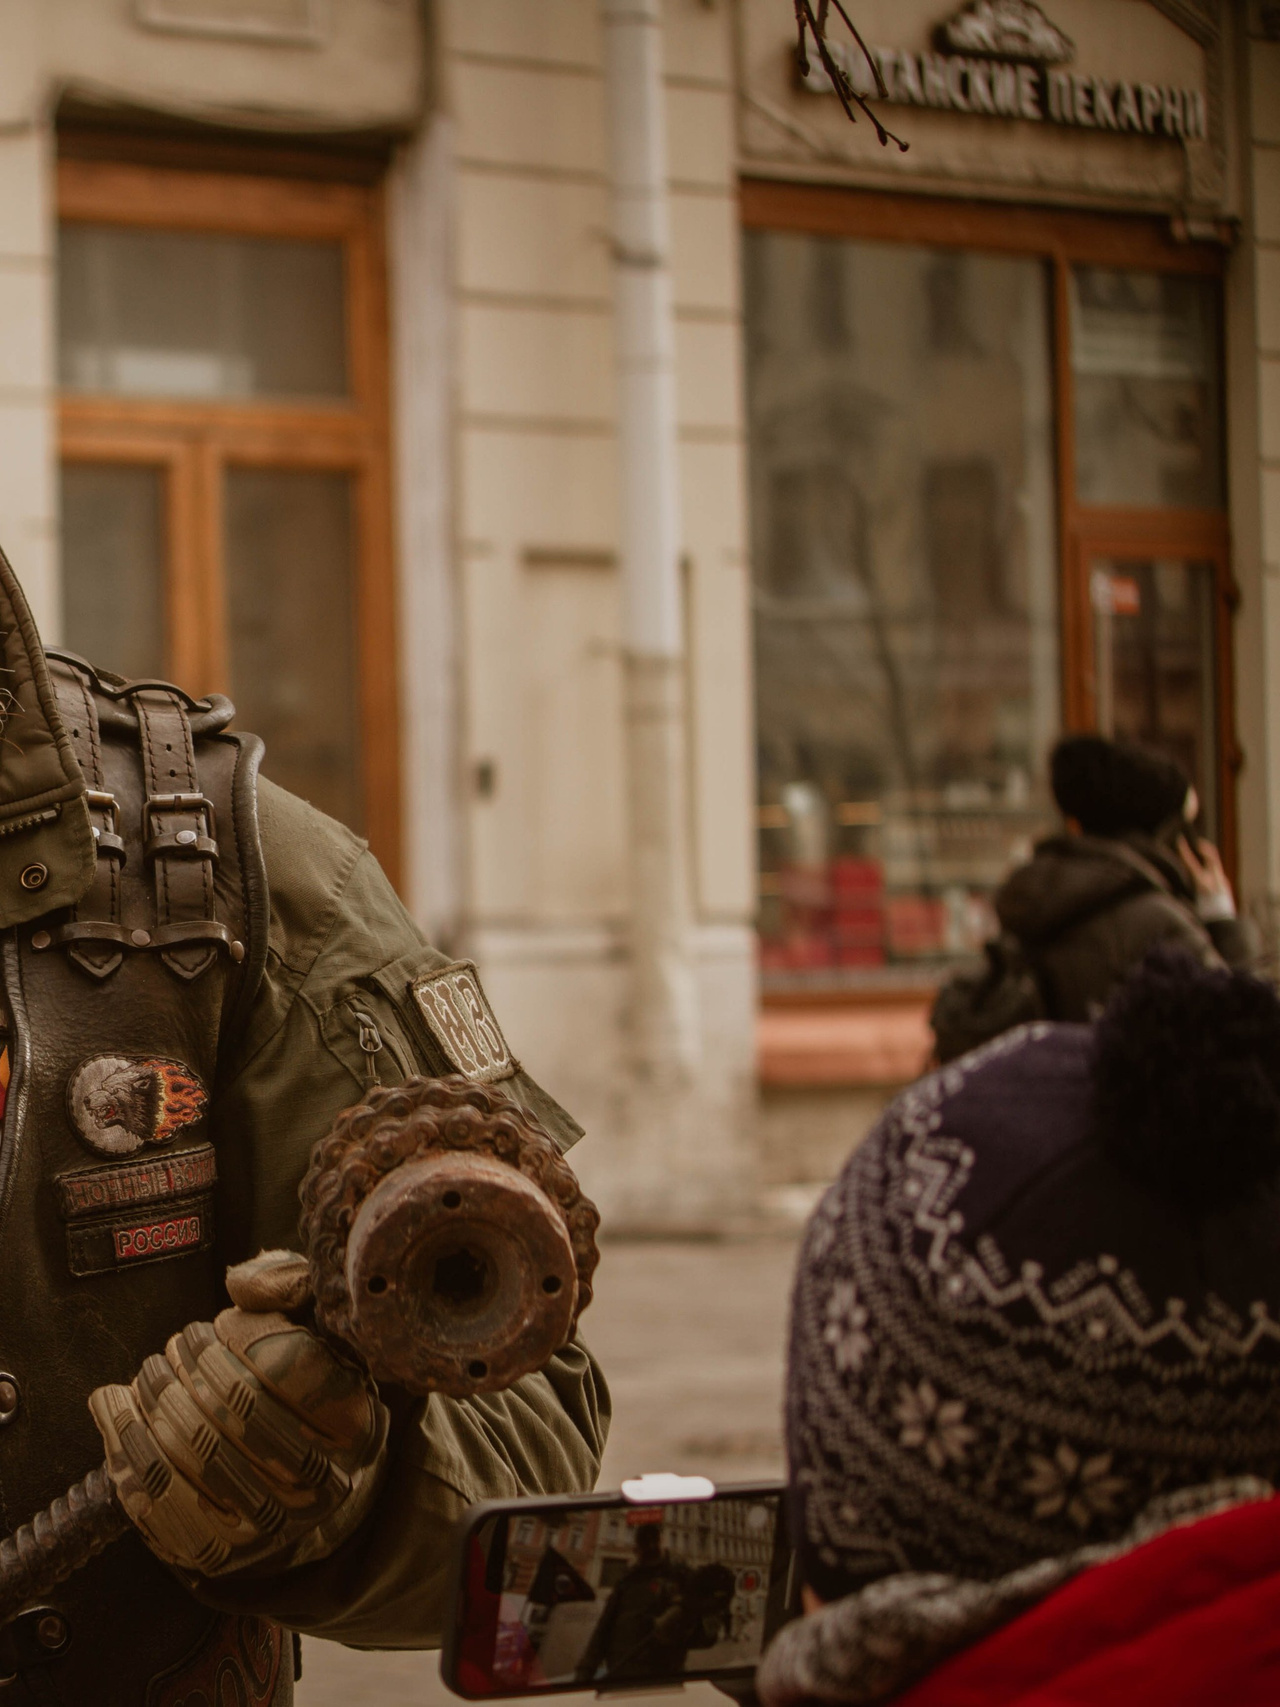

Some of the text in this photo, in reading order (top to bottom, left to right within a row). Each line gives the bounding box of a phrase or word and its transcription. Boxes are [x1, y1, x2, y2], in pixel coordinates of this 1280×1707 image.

[1046, 69, 1208, 139] ПЕКАРНИ
[70, 1170, 169, 1210] НОЧНЫЕ
[117, 1216, 201, 1256] РОССИЯ
